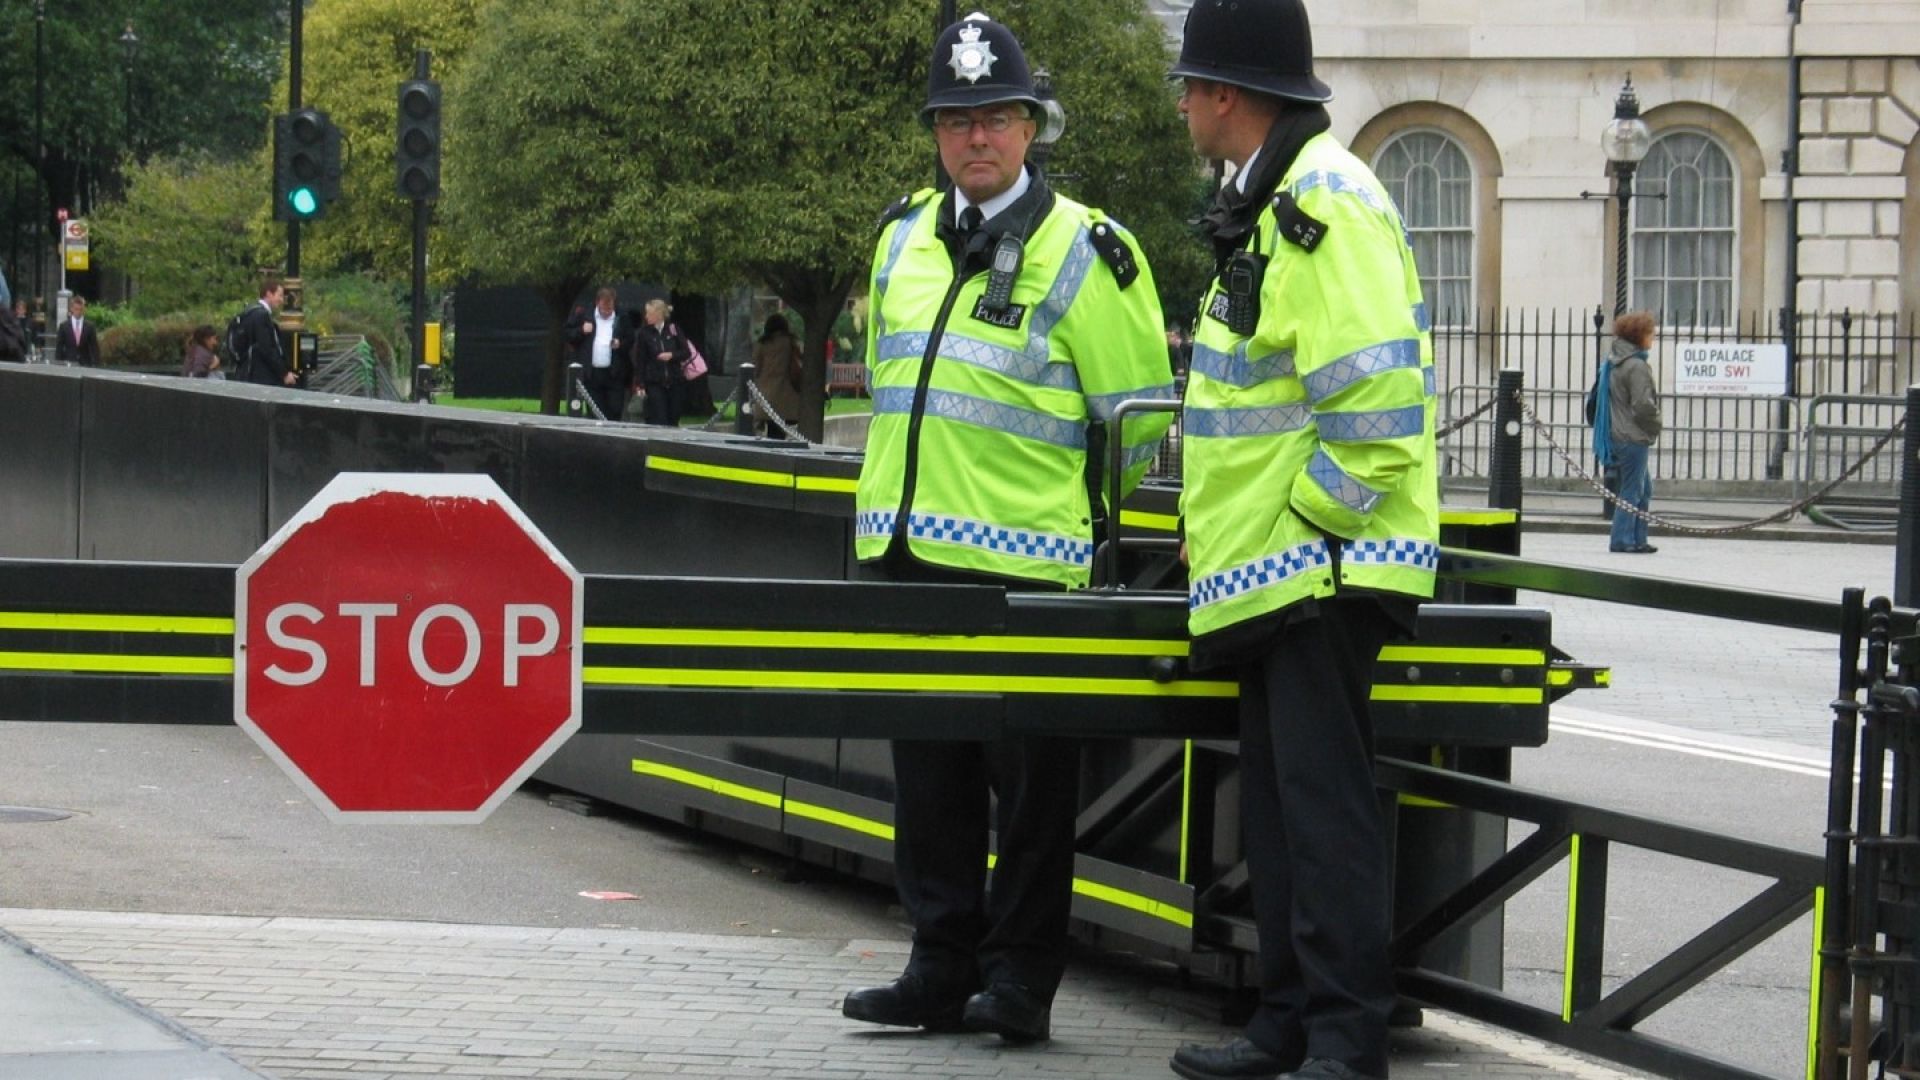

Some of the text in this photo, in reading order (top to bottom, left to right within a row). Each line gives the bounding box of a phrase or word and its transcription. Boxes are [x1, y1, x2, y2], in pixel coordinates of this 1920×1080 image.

[975, 305, 1018, 326] POLICE
[1210, 302, 1229, 322] POL
[1684, 349, 1755, 362] OLD PALACE
[1684, 364, 1751, 378] YARD SW1
[263, 602, 560, 687] STOP
